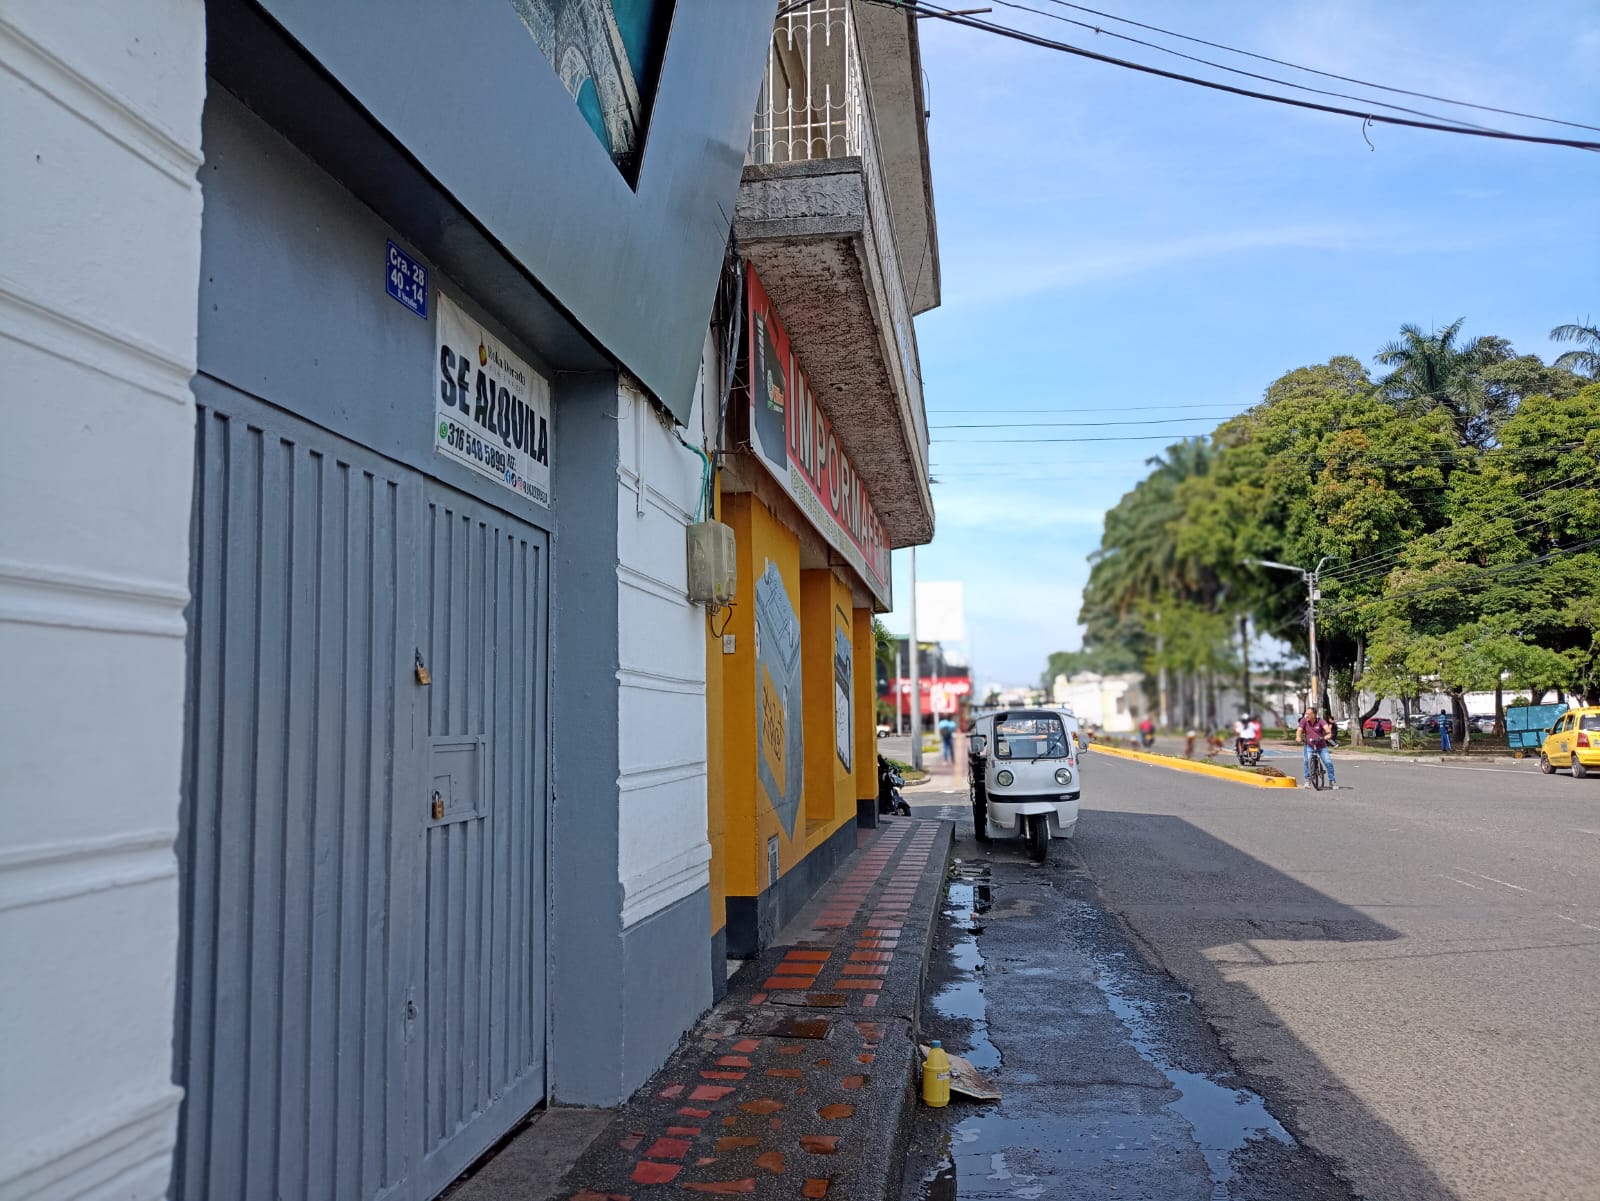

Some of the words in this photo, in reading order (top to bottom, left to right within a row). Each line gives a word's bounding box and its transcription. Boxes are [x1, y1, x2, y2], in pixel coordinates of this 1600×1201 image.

[390, 247, 410, 276] Cra.
[413, 265, 424, 287] 28
[391, 269, 403, 290] 40
[412, 284, 423, 304] 14
[441, 345, 470, 416] SE
[474, 369, 548, 467] ALQUILA
[448, 423, 464, 451] 316
[466, 433, 483, 462] 548
[484, 445, 506, 474] 5899
